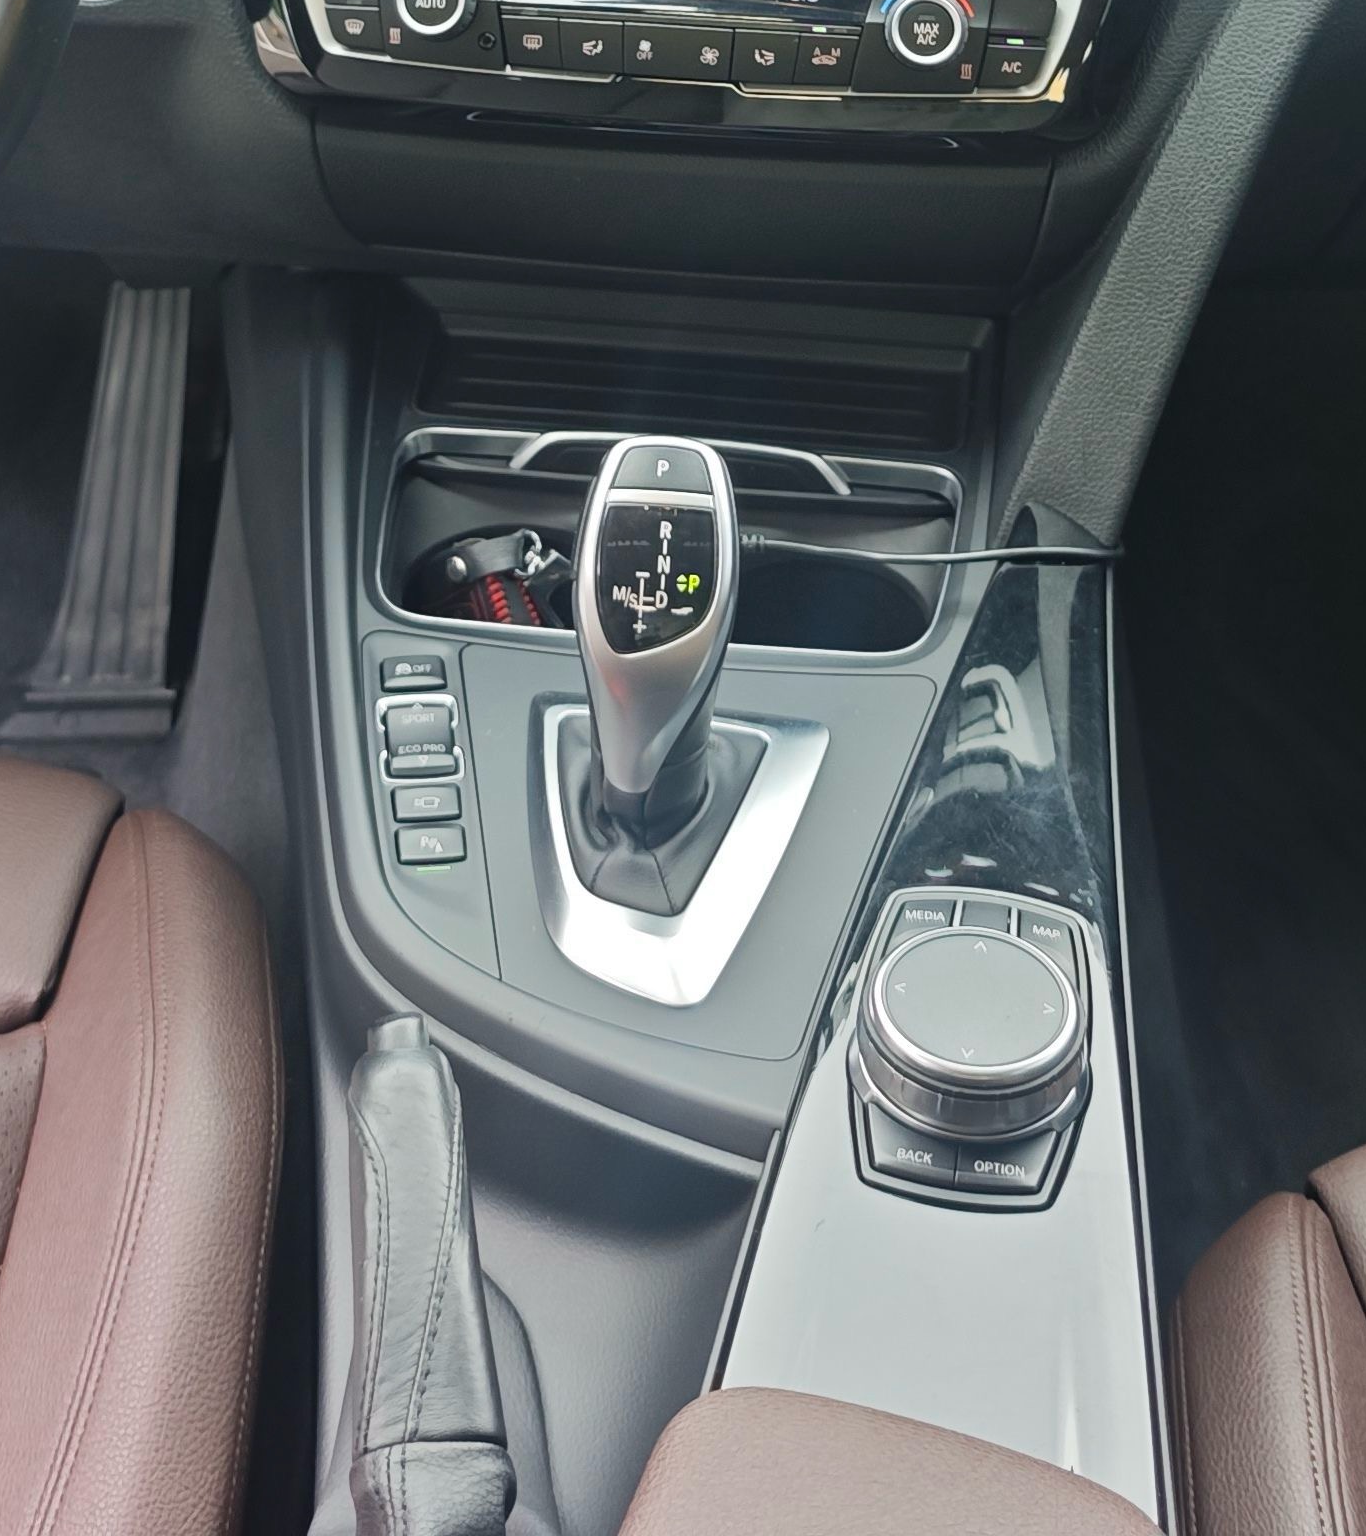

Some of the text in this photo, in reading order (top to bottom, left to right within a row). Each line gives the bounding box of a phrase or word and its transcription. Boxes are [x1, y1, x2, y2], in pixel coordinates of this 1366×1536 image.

[913, 22, 939, 35] MAX
[916, 34, 937, 46] A/C
[636, 51, 653, 62] OFF
[1001, 61, 1022, 74] A/C
[657, 460, 670, 477] P
[660, 521, 672, 539] R
[657, 555, 670, 574] N
[688, 575, 700, 594] P
[655, 590, 668, 609] D
[412, 664, 432, 673] OFF
[402, 712, 436, 723] SPORT
[398, 743, 446, 754] ECO PRO
[905, 909, 946, 924] MEDIA
[1032, 925, 1061, 939] MAP
[896, 1148, 933, 1164] BACK
[974, 1160, 1026, 1178] OPTION
